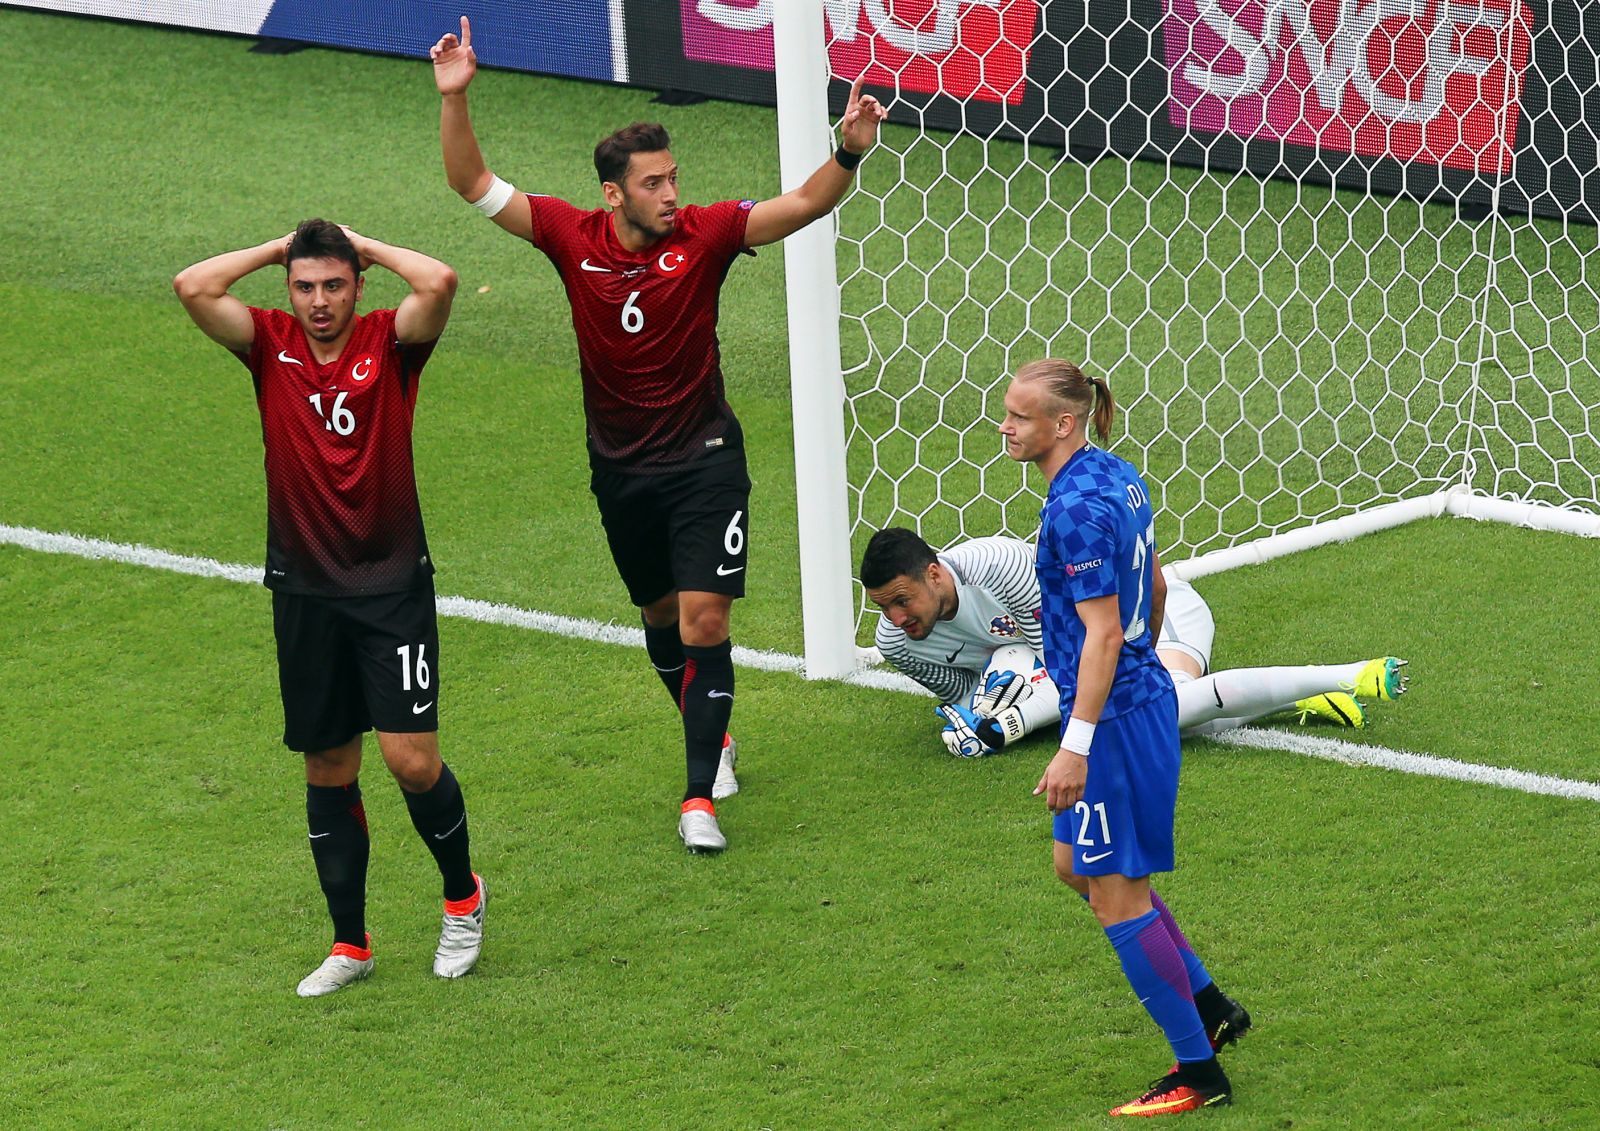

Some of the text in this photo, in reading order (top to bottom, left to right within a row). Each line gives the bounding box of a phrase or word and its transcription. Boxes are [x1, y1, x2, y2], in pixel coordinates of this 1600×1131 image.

[621, 291, 645, 334] 6
[308, 391, 356, 436] 16
[724, 510, 744, 556] 6
[1073, 558, 1103, 573] RESPECT
[396, 643, 430, 691] 16
[1005, 713, 1020, 736] SUBA
[1074, 800, 1112, 847] 21
